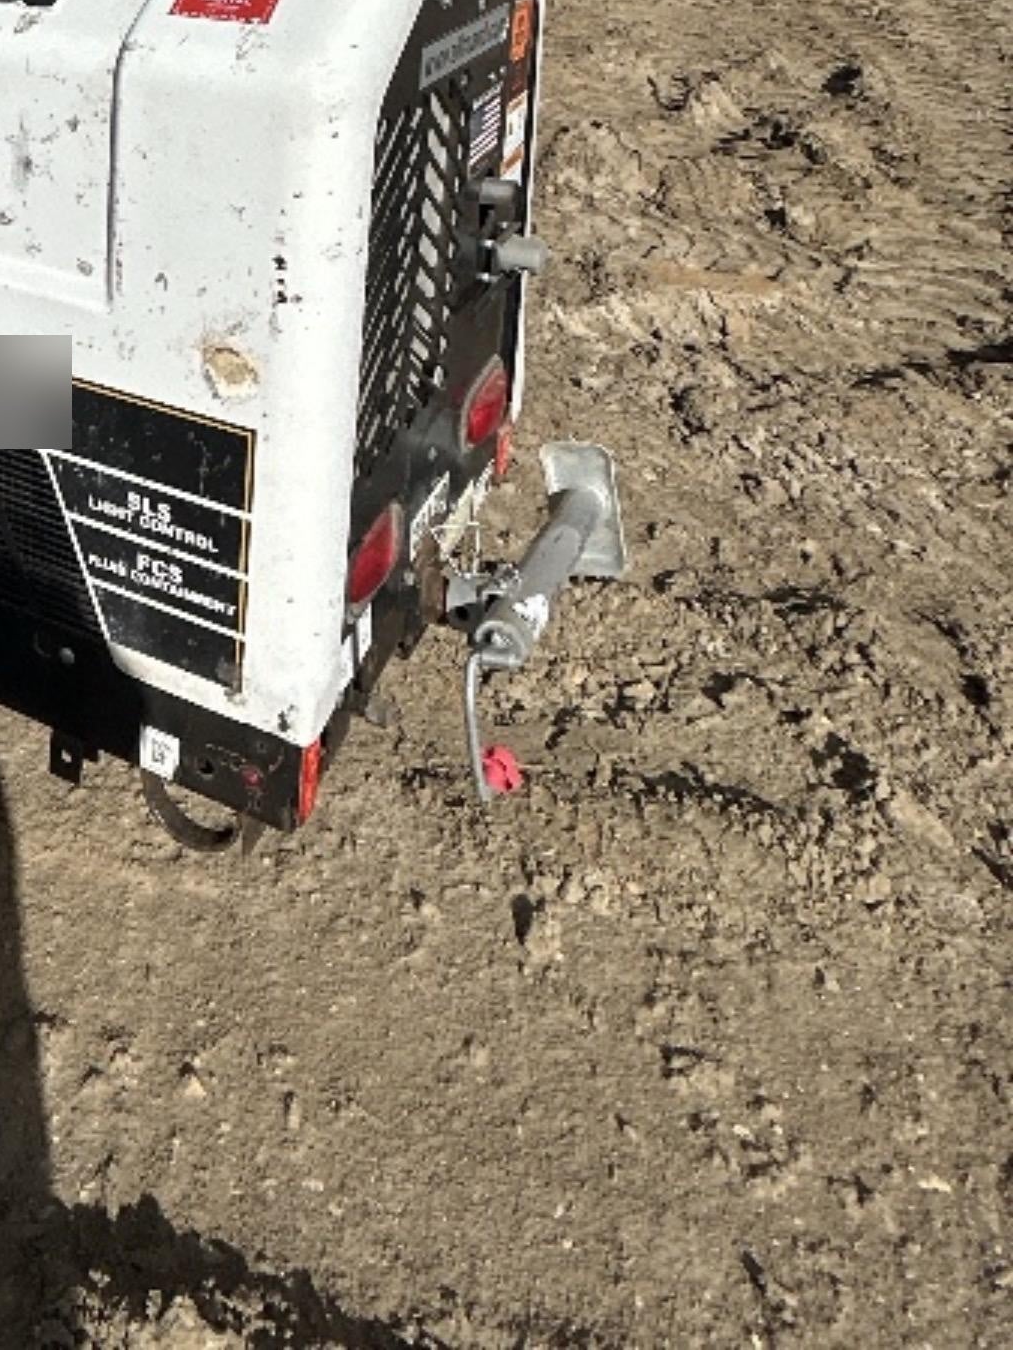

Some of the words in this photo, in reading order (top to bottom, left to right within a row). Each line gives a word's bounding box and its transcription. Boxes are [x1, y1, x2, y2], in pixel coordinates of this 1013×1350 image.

[127, 491, 172, 523] SLS
[139, 515, 219, 553] CONTROL
[136, 553, 183, 584] FCS
